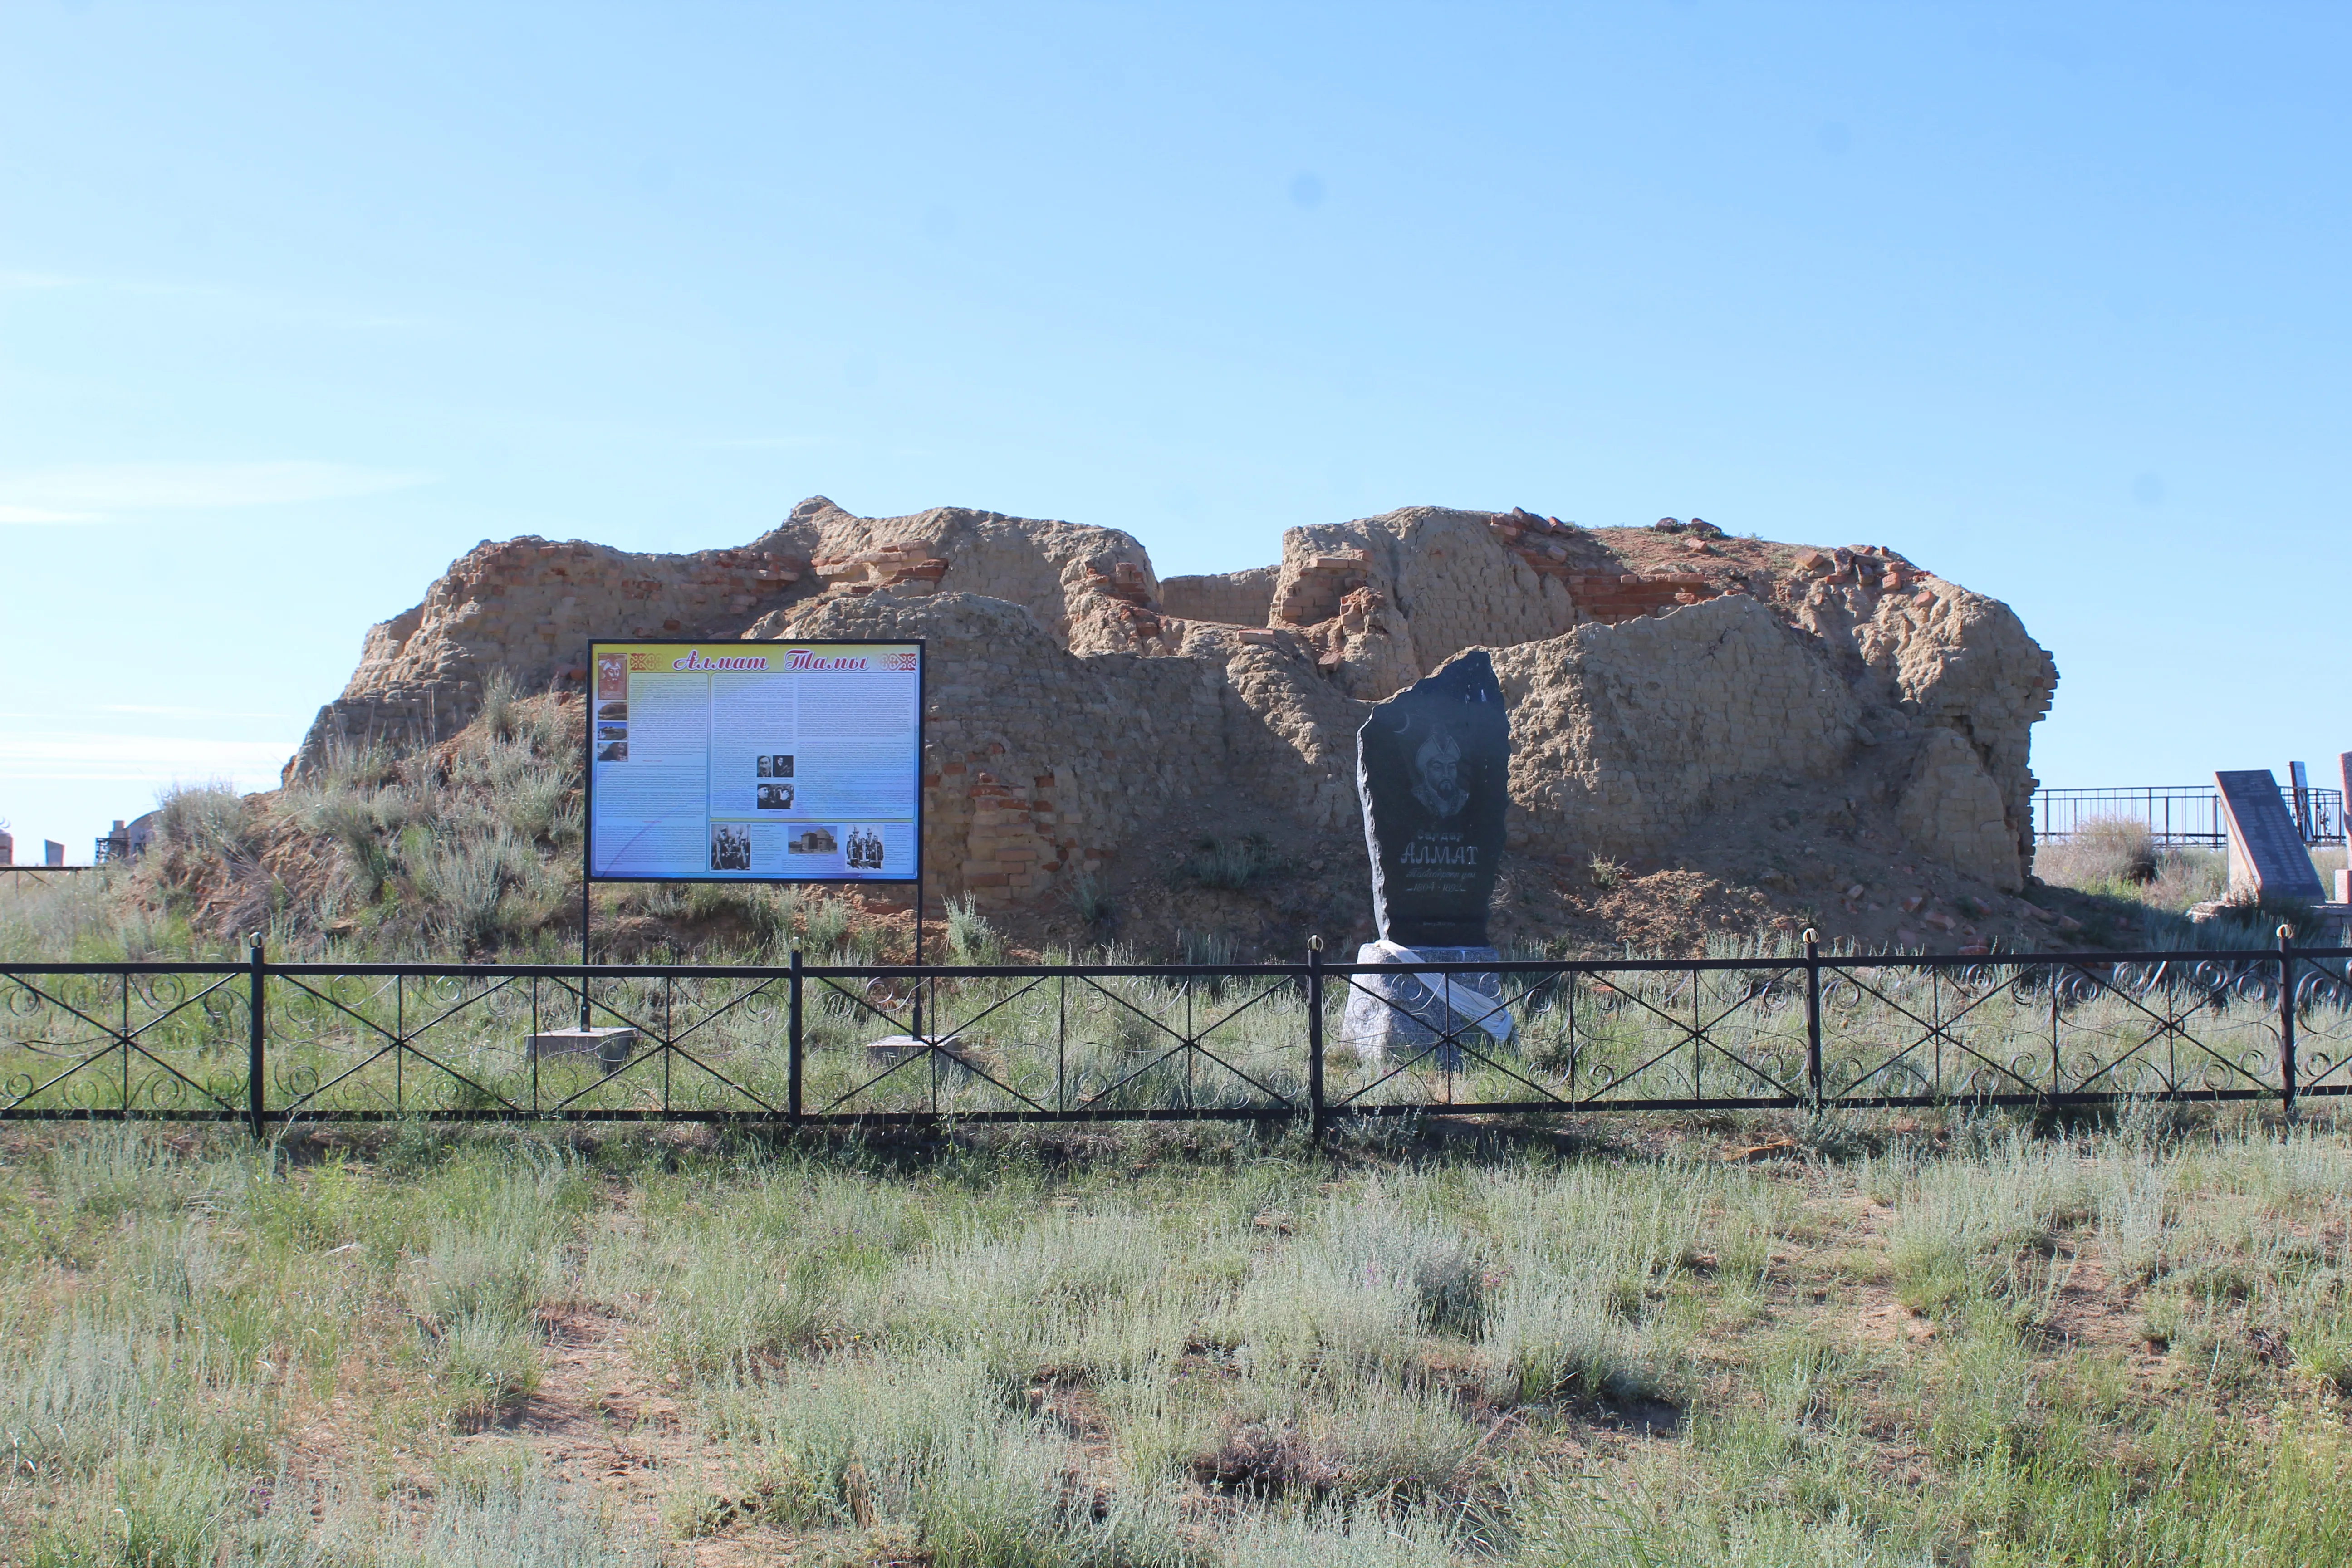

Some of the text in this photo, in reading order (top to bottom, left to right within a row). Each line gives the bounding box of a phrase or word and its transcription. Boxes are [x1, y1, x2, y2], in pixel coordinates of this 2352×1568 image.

[672, 649, 870, 671] Алмат Тамы
[1417, 829, 1464, 842] Сардар
[1400, 842, 1478, 865] АЛМАТ
[1413, 882, 1462, 892] 1804 1892
